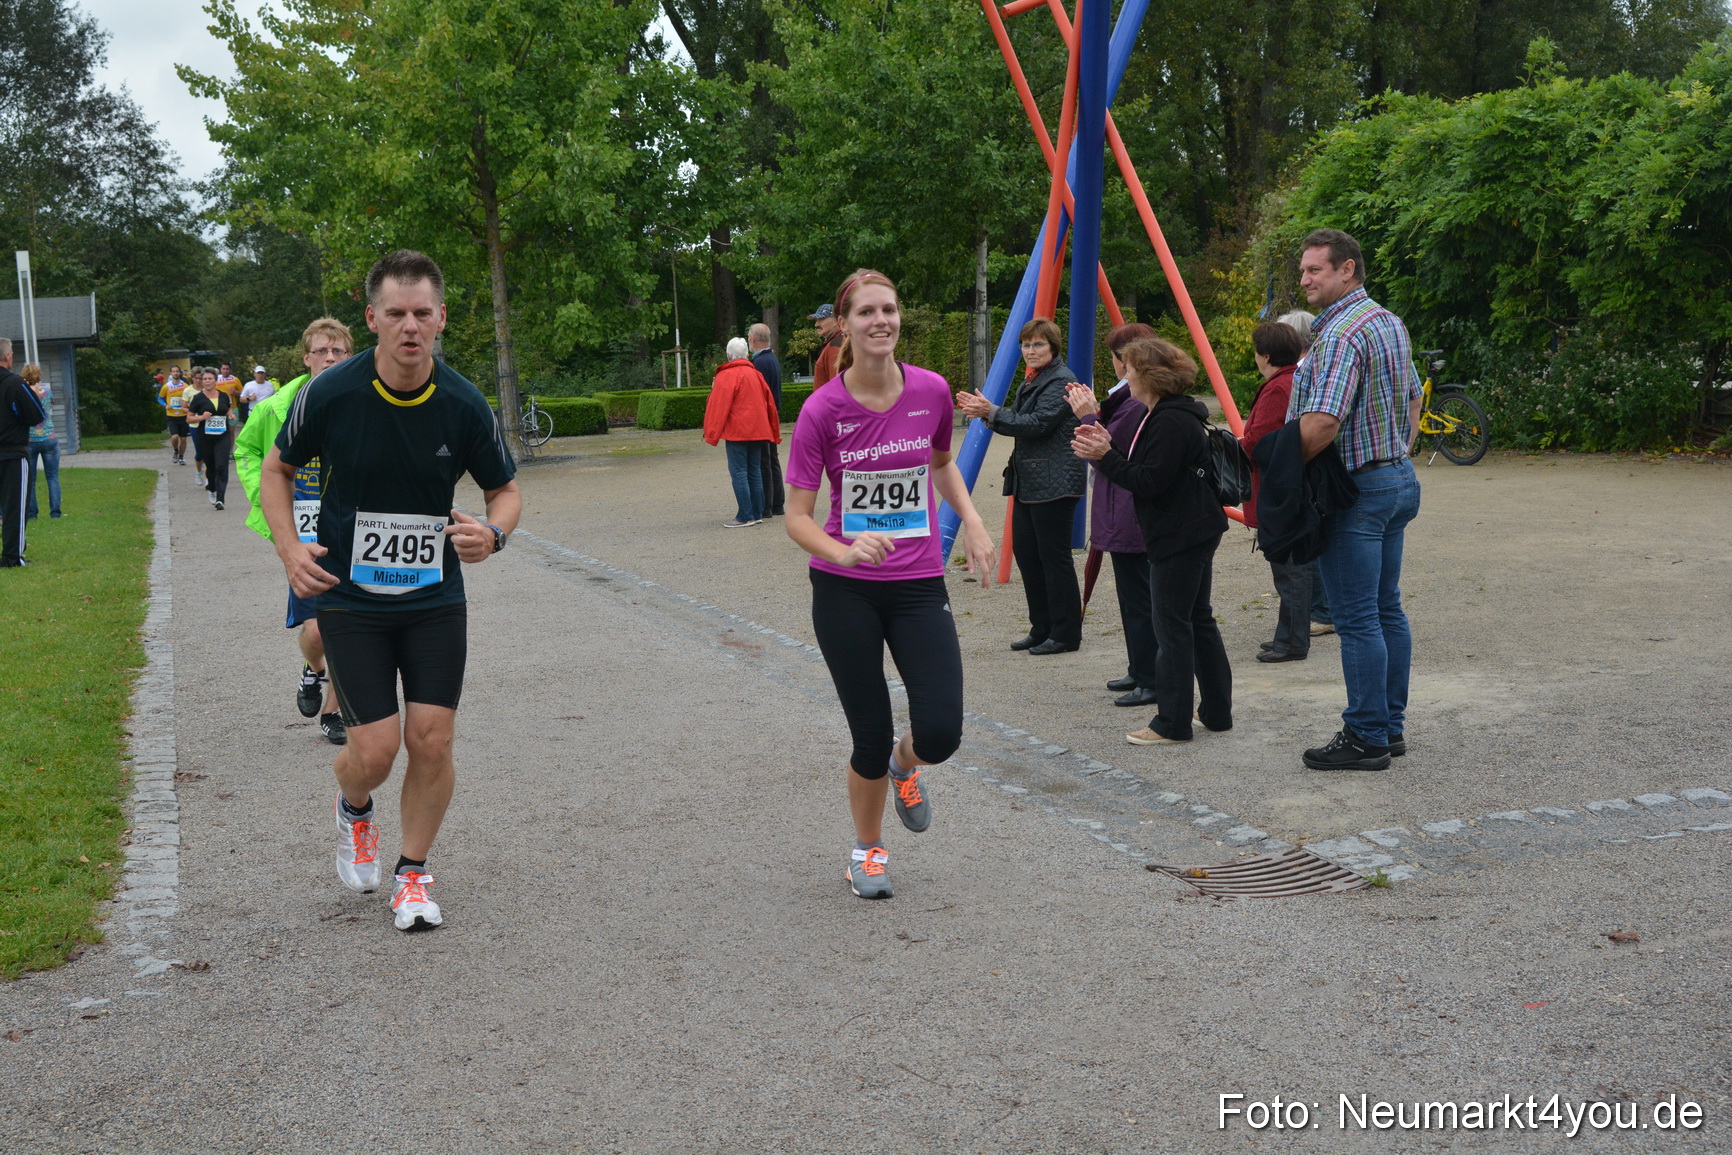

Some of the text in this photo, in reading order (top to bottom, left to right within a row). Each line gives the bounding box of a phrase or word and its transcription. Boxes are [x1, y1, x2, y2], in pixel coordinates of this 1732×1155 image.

[840, 434, 931, 463] Energiebündel
[844, 470, 915, 481] PARTL Neumarkt
[851, 480, 921, 510] 2494
[357, 519, 431, 531] PARTL Neumarkt
[866, 516, 905, 529] Marina
[362, 532, 436, 565] 2495
[373, 570, 420, 584] Michael
